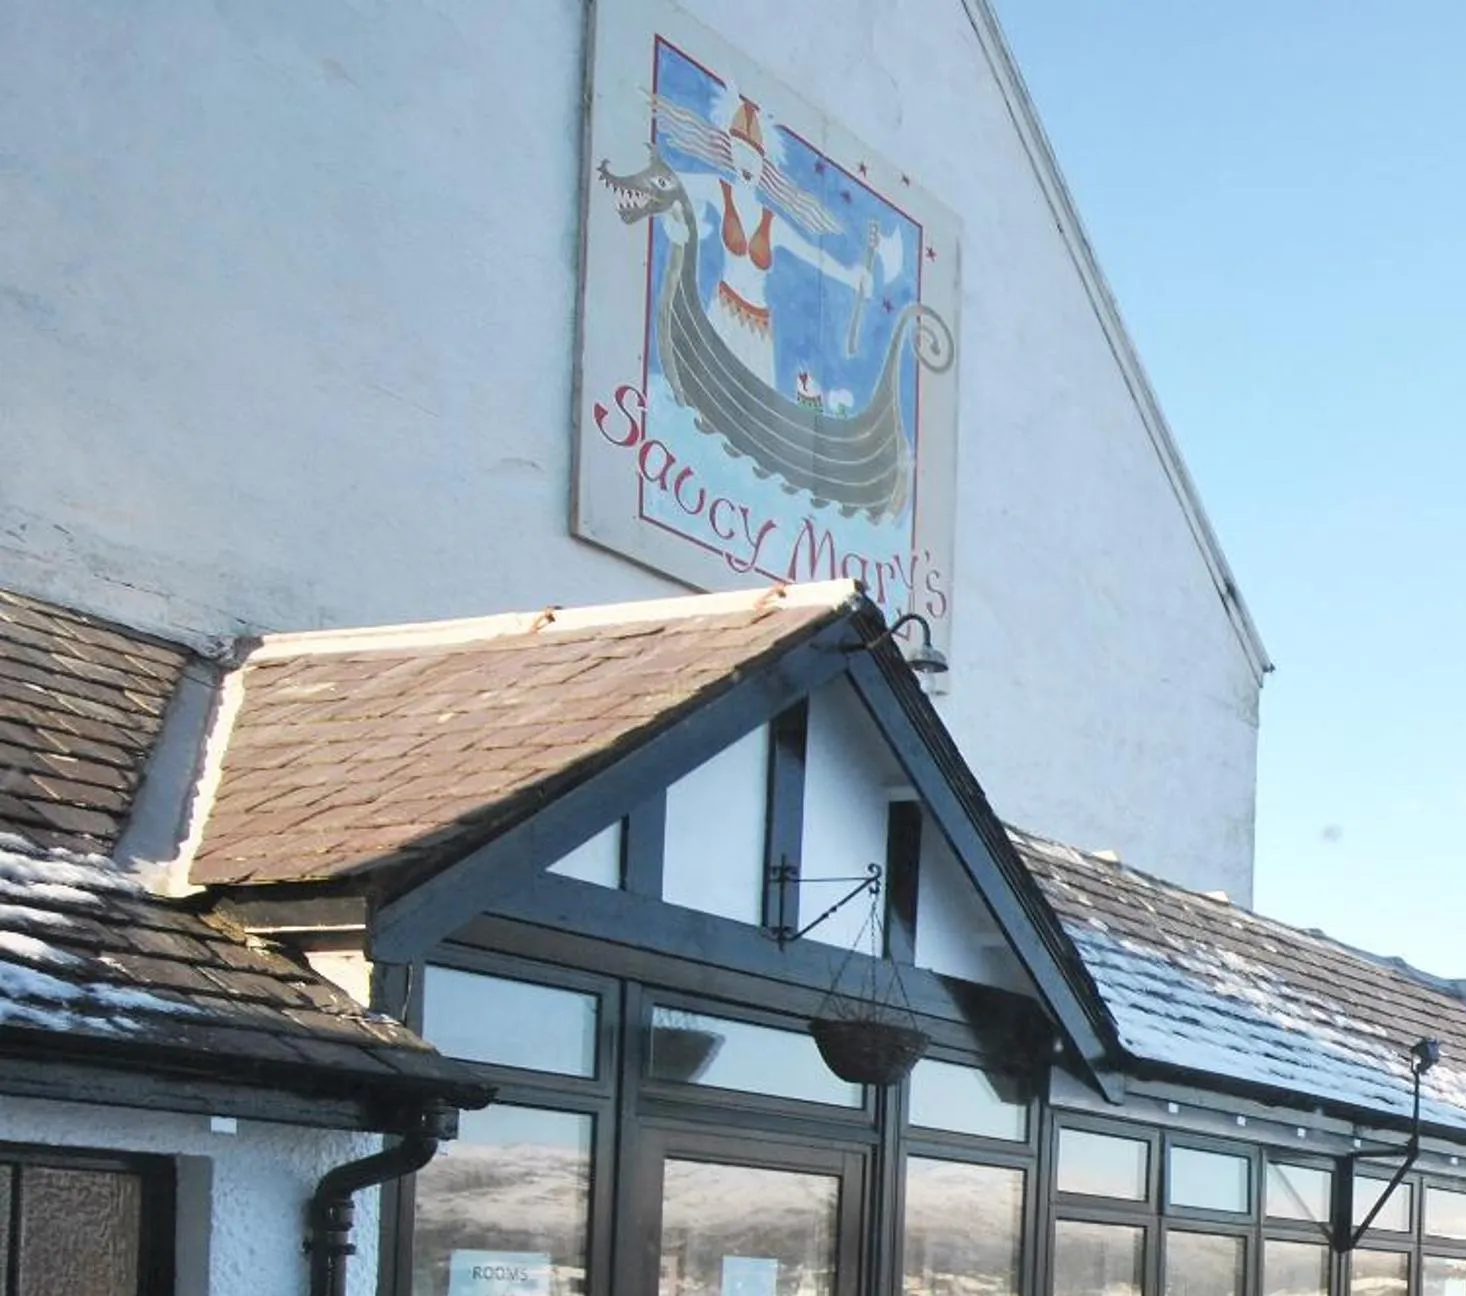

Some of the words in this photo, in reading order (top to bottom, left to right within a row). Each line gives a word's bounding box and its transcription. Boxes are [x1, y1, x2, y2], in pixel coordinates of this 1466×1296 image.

[594, 384, 775, 573] Saucy
[787, 517, 946, 618] Mary's
[472, 1266, 529, 1281] ROOMS
